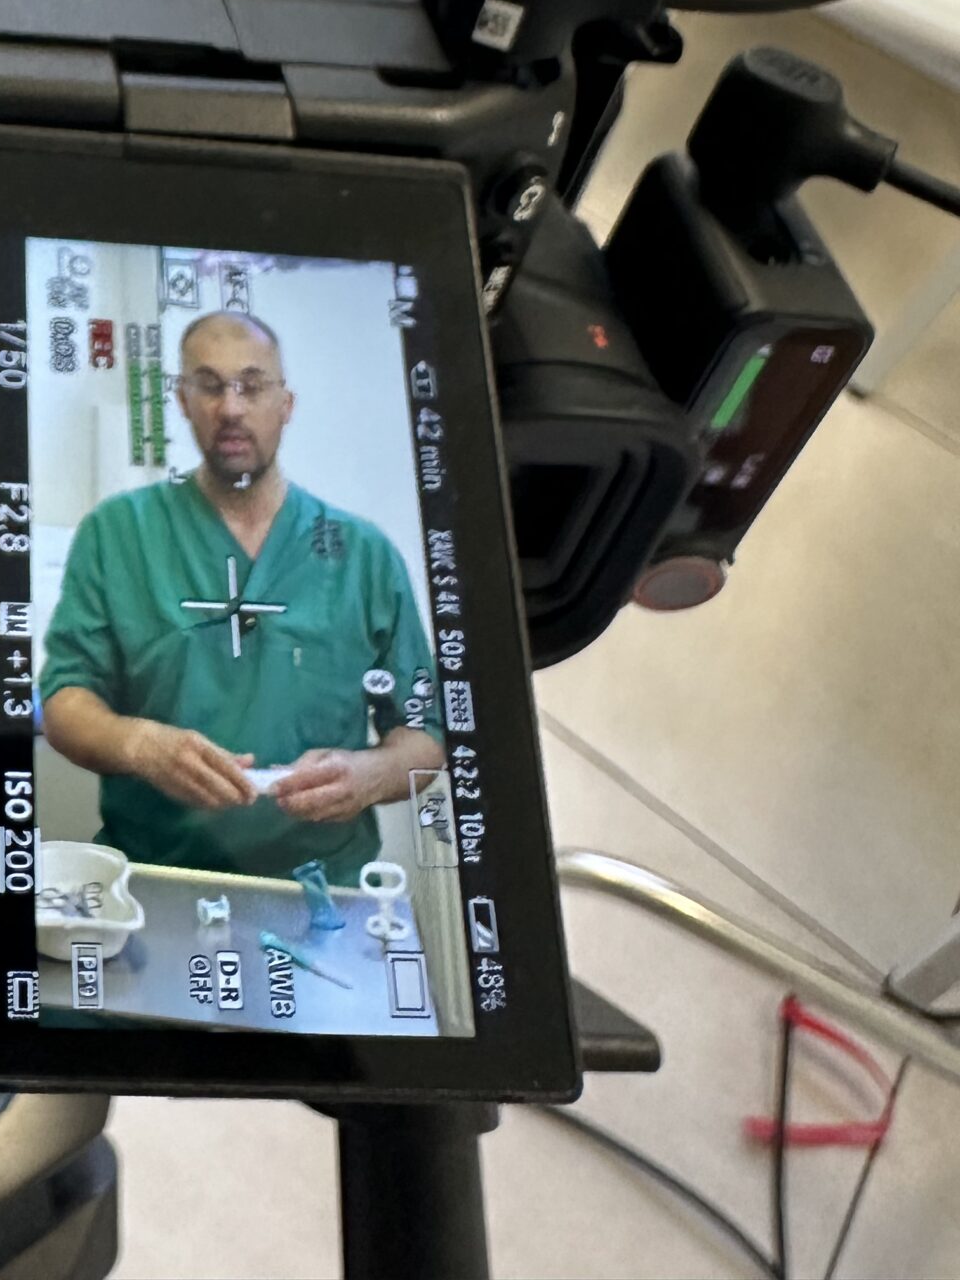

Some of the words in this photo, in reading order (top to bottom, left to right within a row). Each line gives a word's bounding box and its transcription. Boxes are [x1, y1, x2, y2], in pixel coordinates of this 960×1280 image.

[417, 407, 443, 440] 42
[420, 446, 446, 490] min
[439, 629, 465, 670] 50p
[3, 650, 33, 716] +1.3
[4, 771, 33, 819] ISO
[452, 745, 481, 799] 4:2:2
[4, 828, 34, 893] 200
[459, 812, 485, 863] 10bit
[189, 955, 213, 1004] OFF
[219, 960, 239, 1002] D-R
[266, 949, 296, 1018] AWB
[476, 958, 506, 1012] 48%
